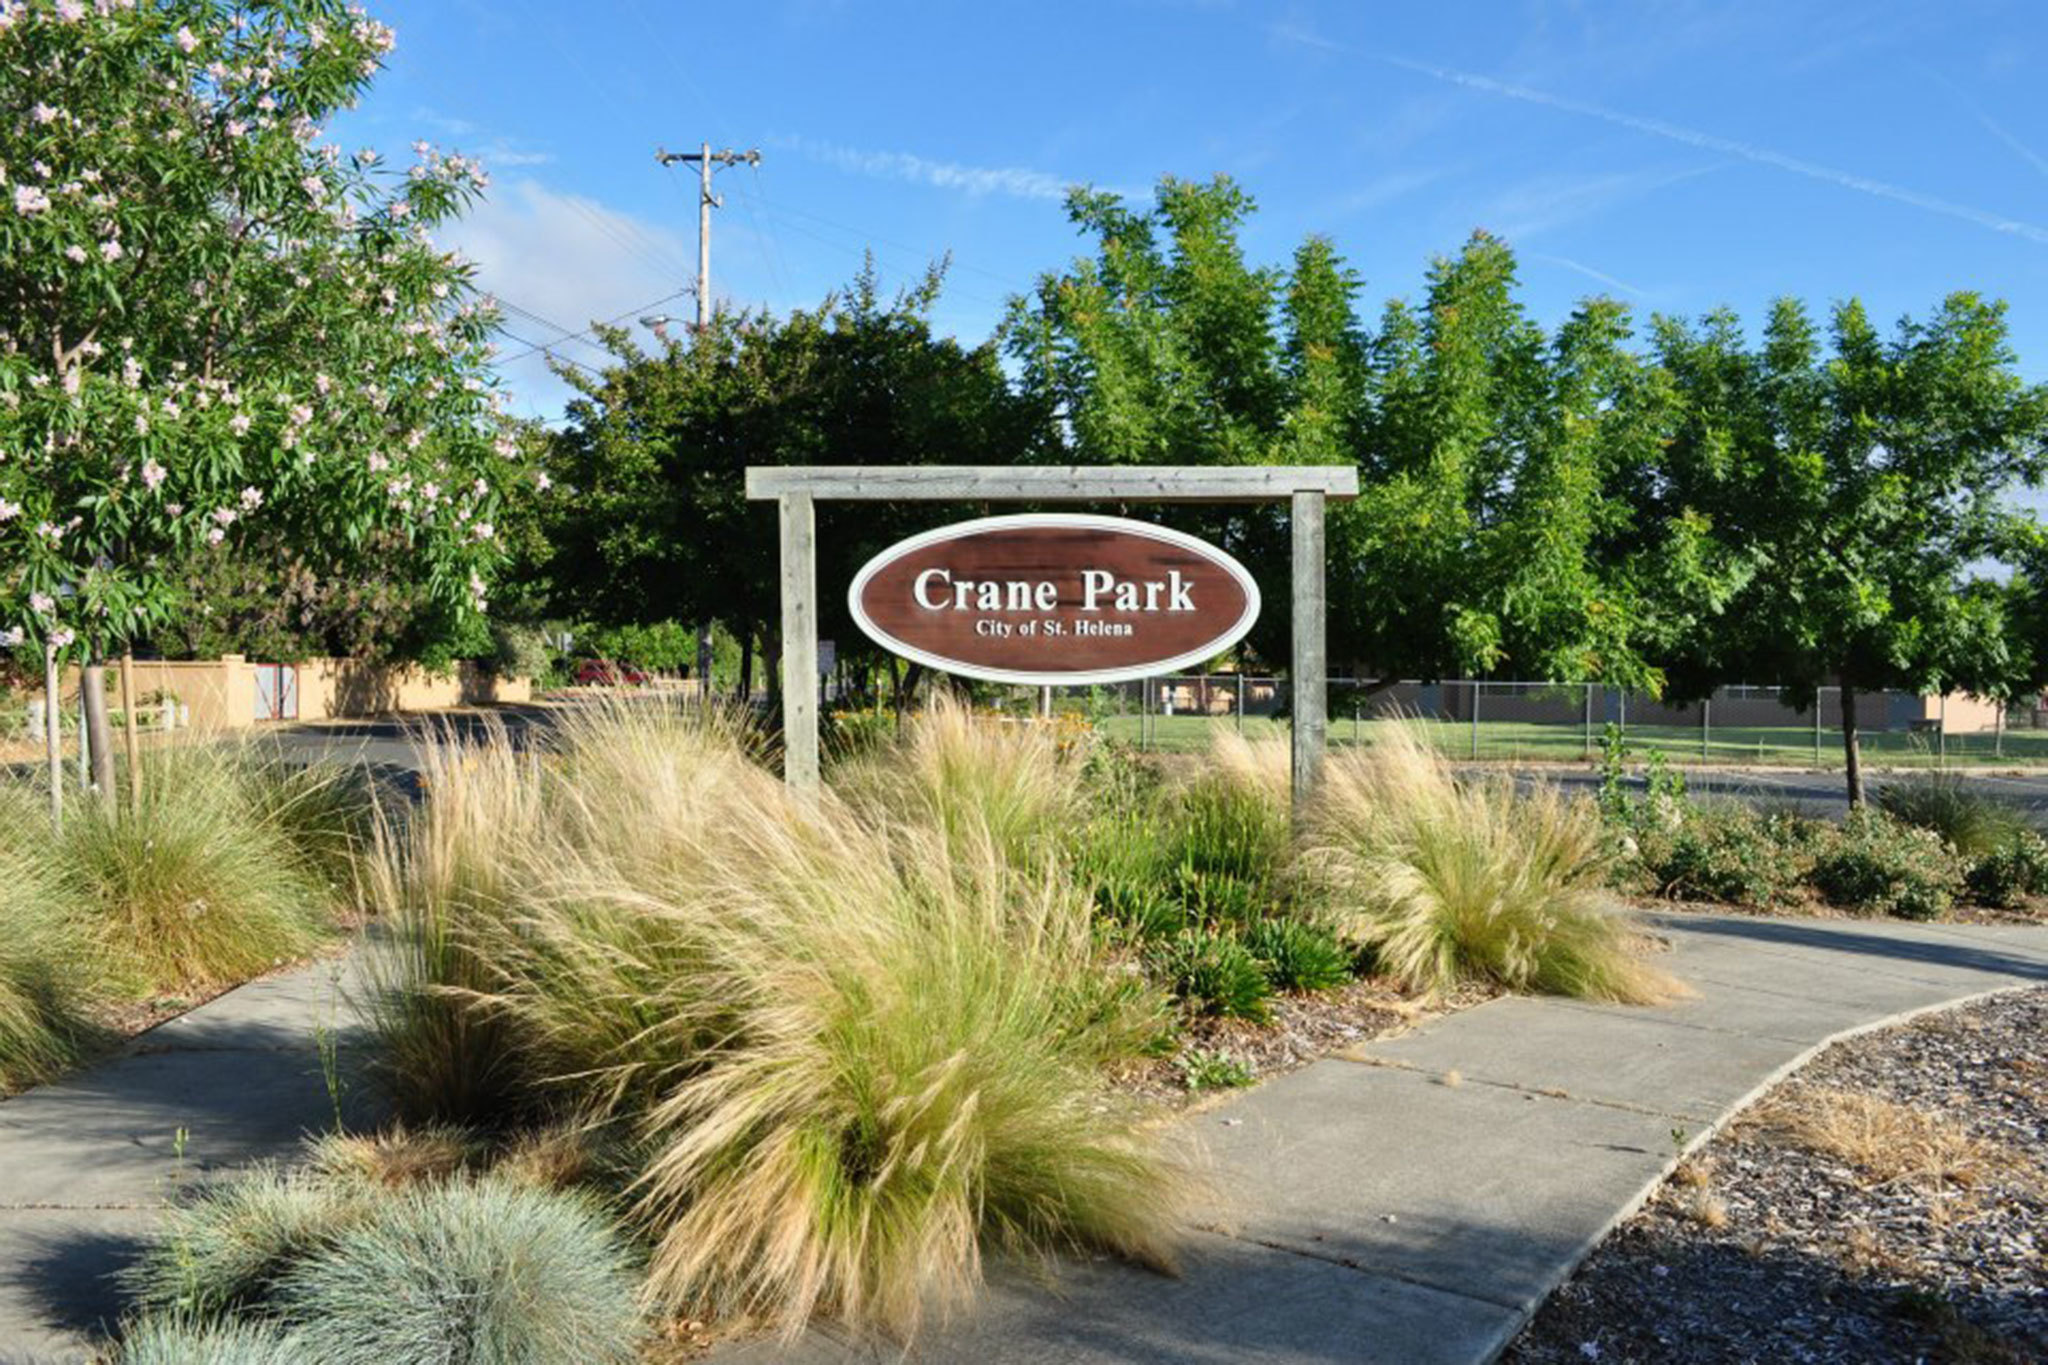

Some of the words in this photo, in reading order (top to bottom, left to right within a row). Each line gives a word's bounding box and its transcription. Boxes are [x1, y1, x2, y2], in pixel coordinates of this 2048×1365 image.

[913, 568, 1058, 612] Crane
[1080, 569, 1197, 612] Park
[976, 619, 1013, 639] City
[1019, 619, 1038, 636] of
[1044, 619, 1068, 636] St.
[1074, 619, 1134, 637] Helena
